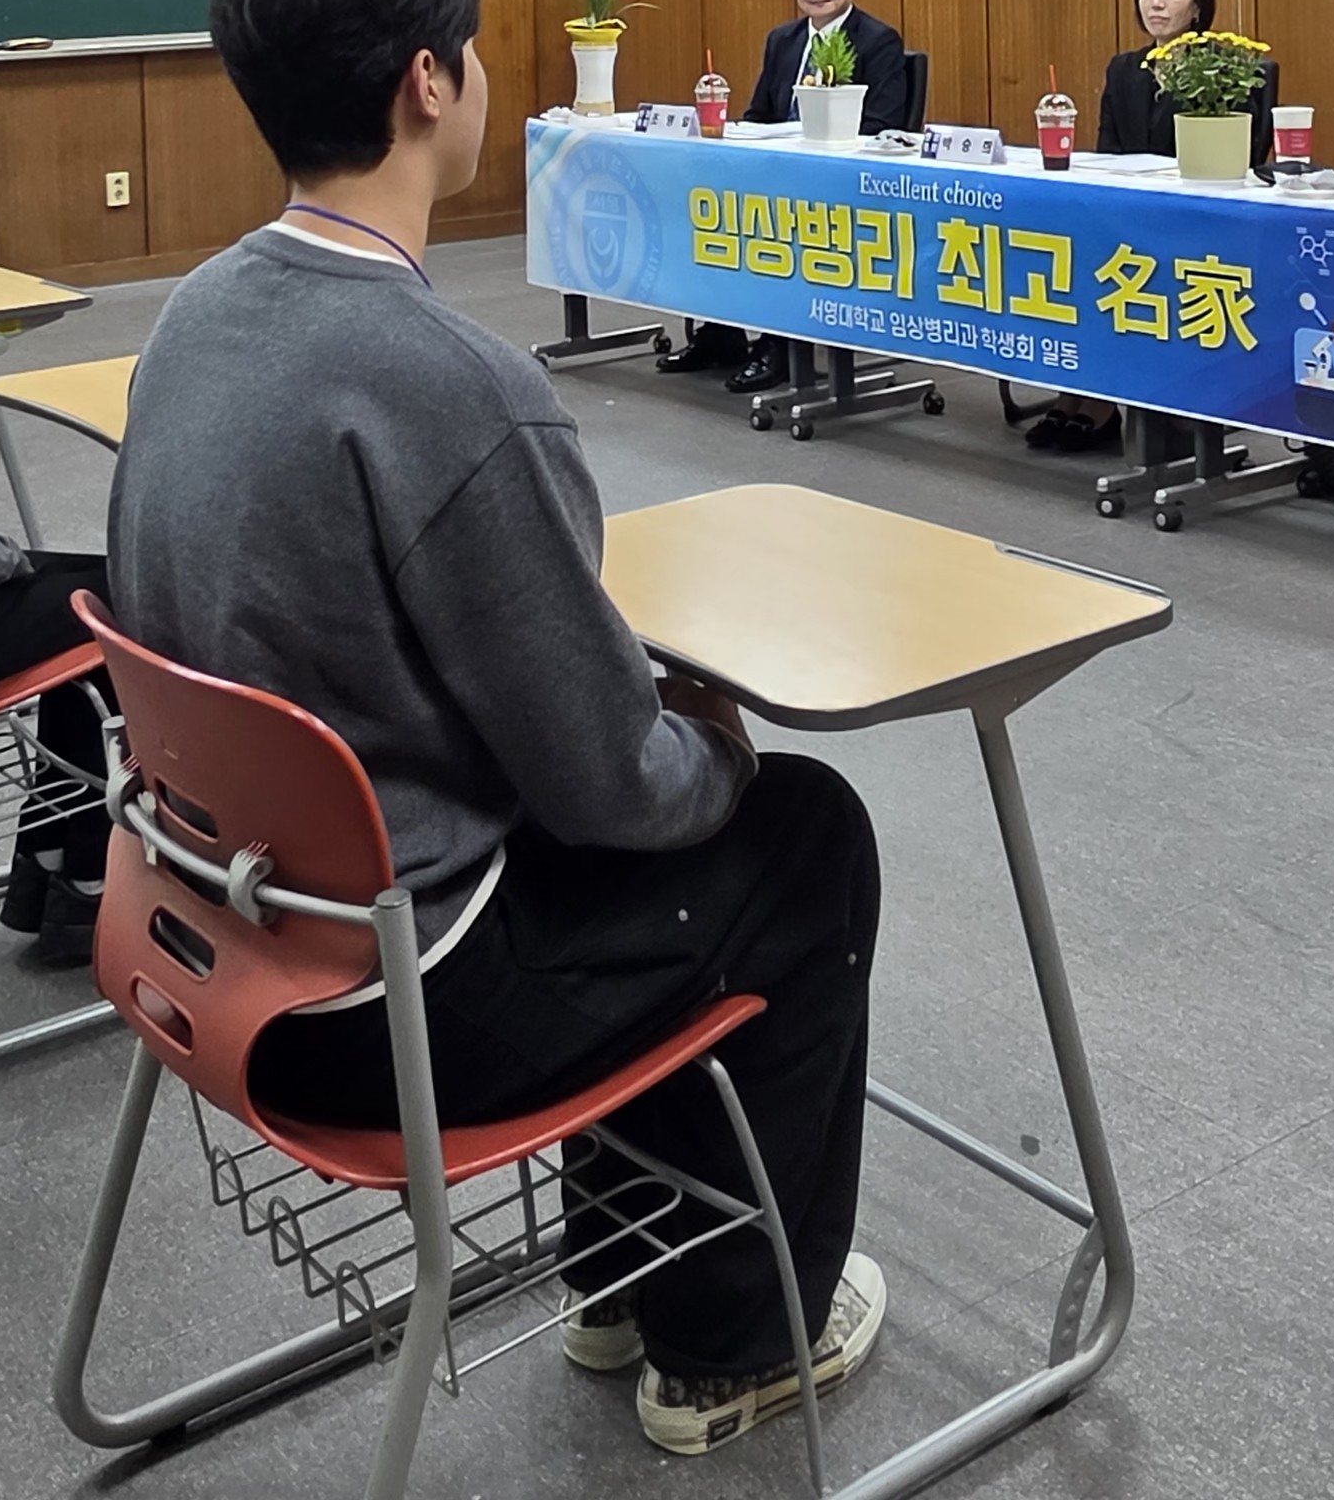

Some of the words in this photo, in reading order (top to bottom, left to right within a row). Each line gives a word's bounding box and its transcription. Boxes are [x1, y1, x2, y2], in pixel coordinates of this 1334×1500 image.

[859, 171, 940, 203] Excellent
[943, 179, 1003, 211] choice
[688, 186, 915, 300] 임상병리
[936, 216, 1078, 325] 최고
[1093, 242, 1259, 351] 名家
[809, 297, 887, 334] 서영대학교
[889, 311, 979, 350] 임상병리과
[980, 327, 1035, 362] 학생회
[1039, 338, 1079, 370] 일동
